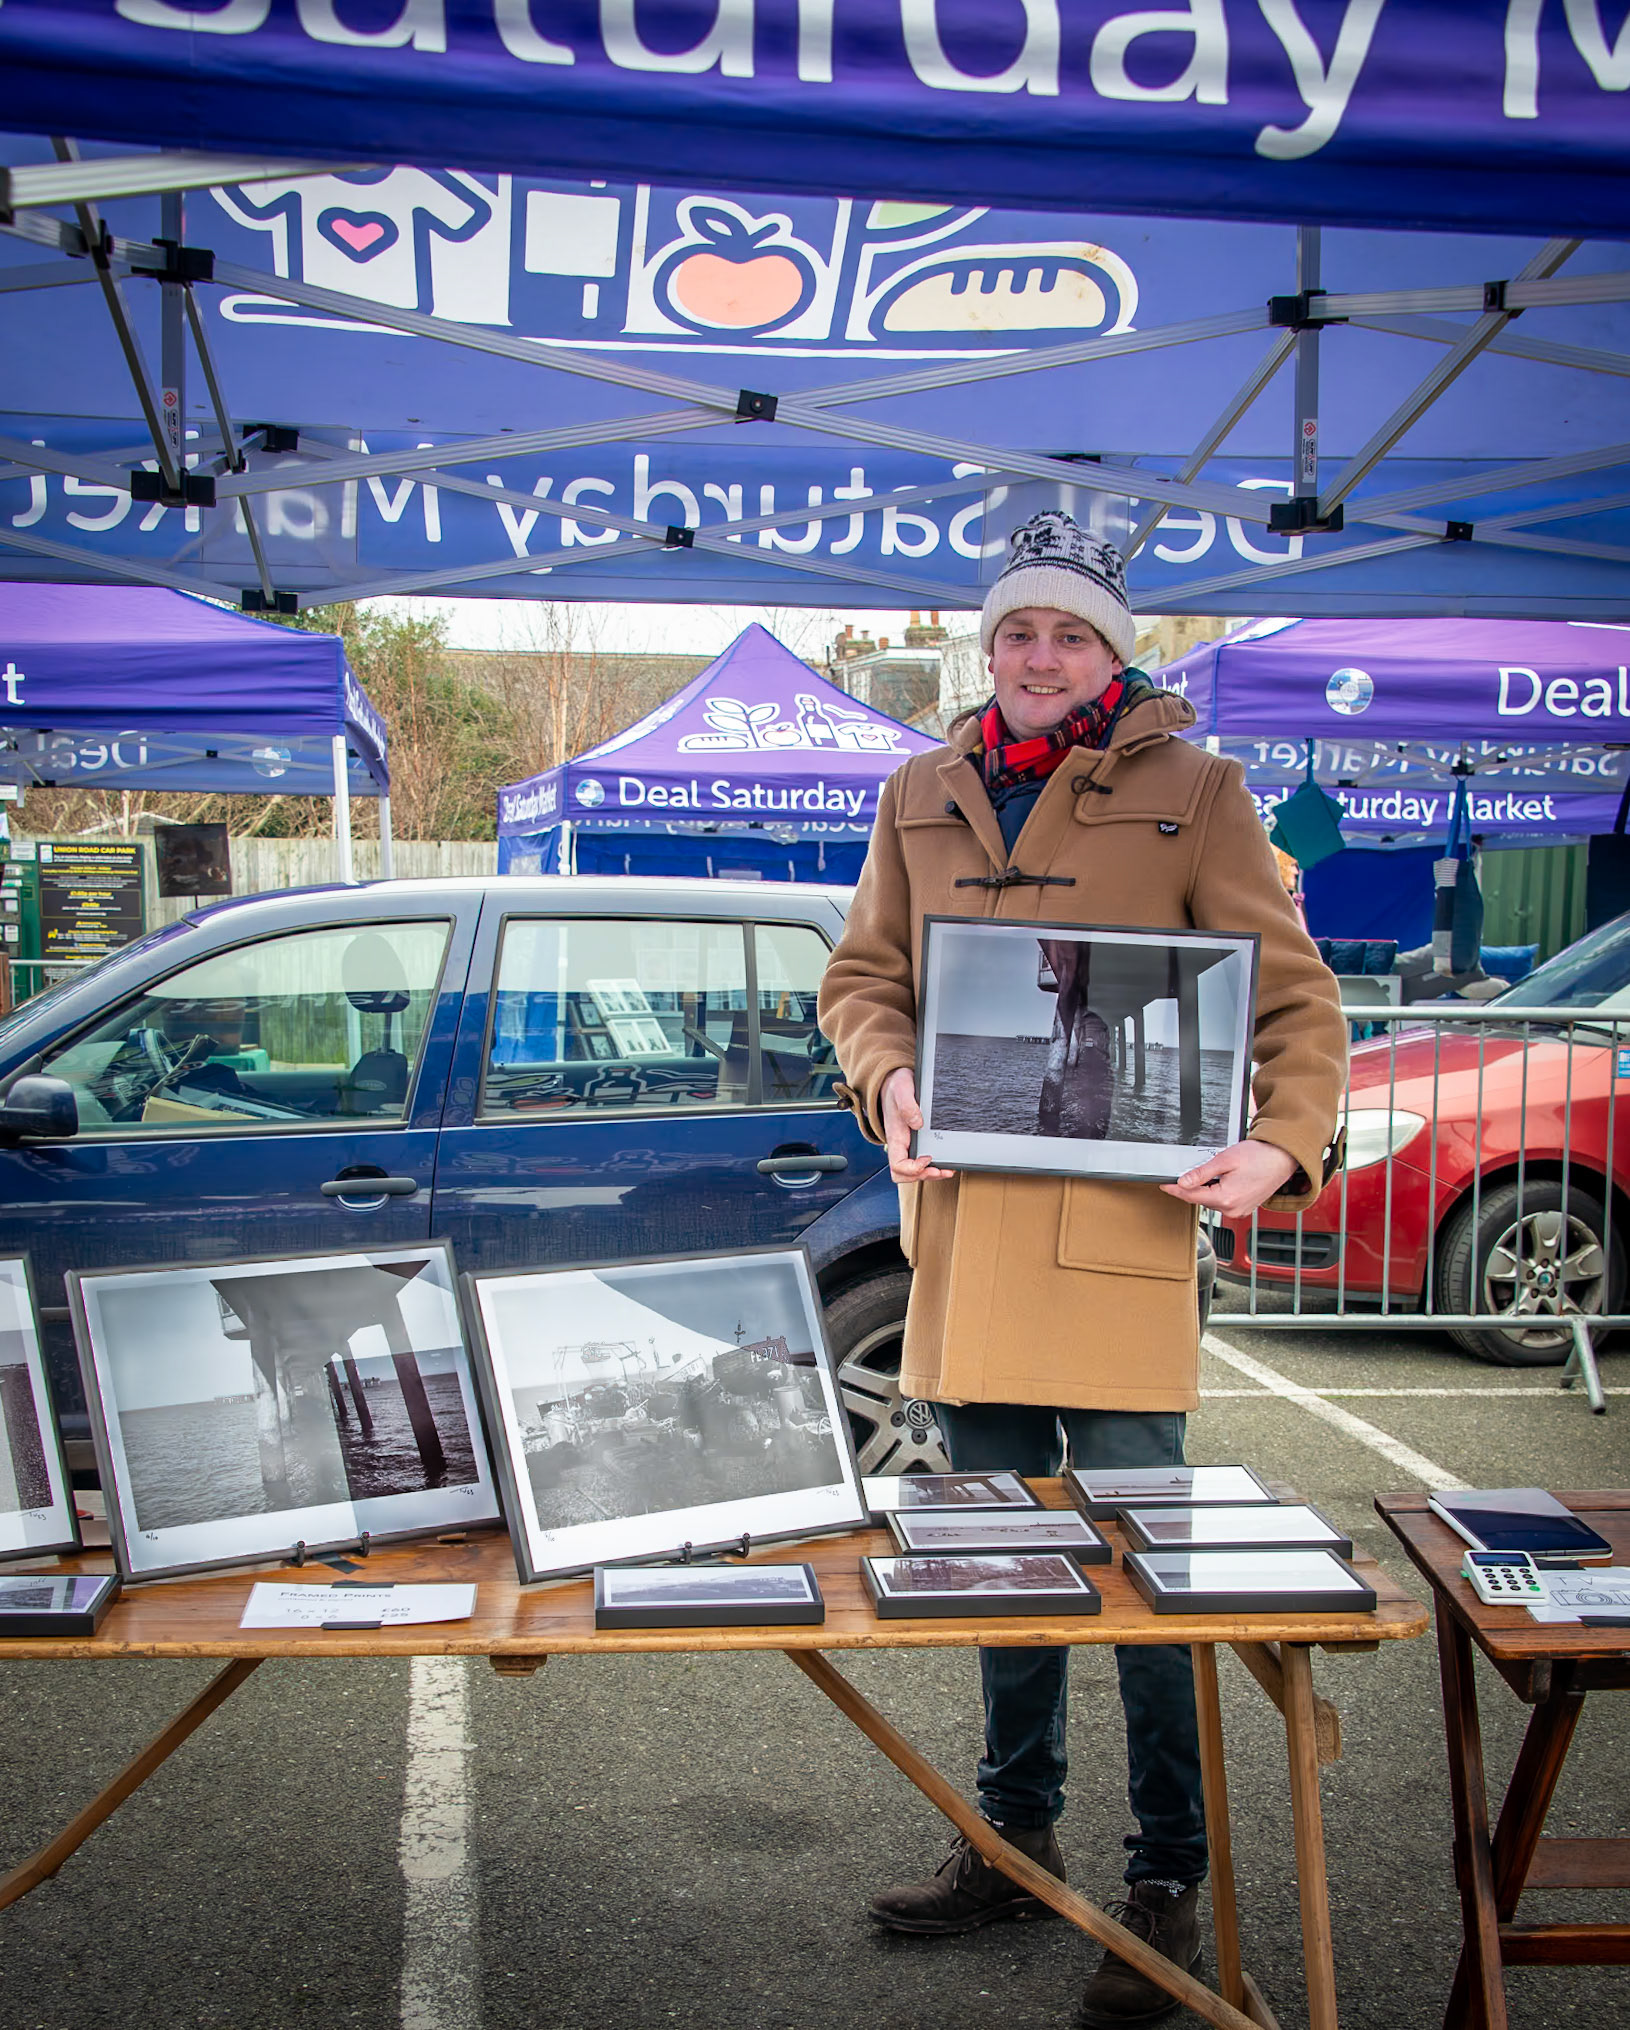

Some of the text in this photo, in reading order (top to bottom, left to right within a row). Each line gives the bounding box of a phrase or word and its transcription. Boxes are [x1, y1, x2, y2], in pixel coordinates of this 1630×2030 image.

[115, 0, 1384, 160] aturday
[1497, 666, 1630, 718] Deal
[618, 776, 702, 808] Deal
[710, 777, 867, 817] Saturday
[1336, 789, 1440, 827] turday
[53, 846, 78, 854] UNION
[78, 846, 100, 854] ROAD
[116, 847, 137, 855] PARK
